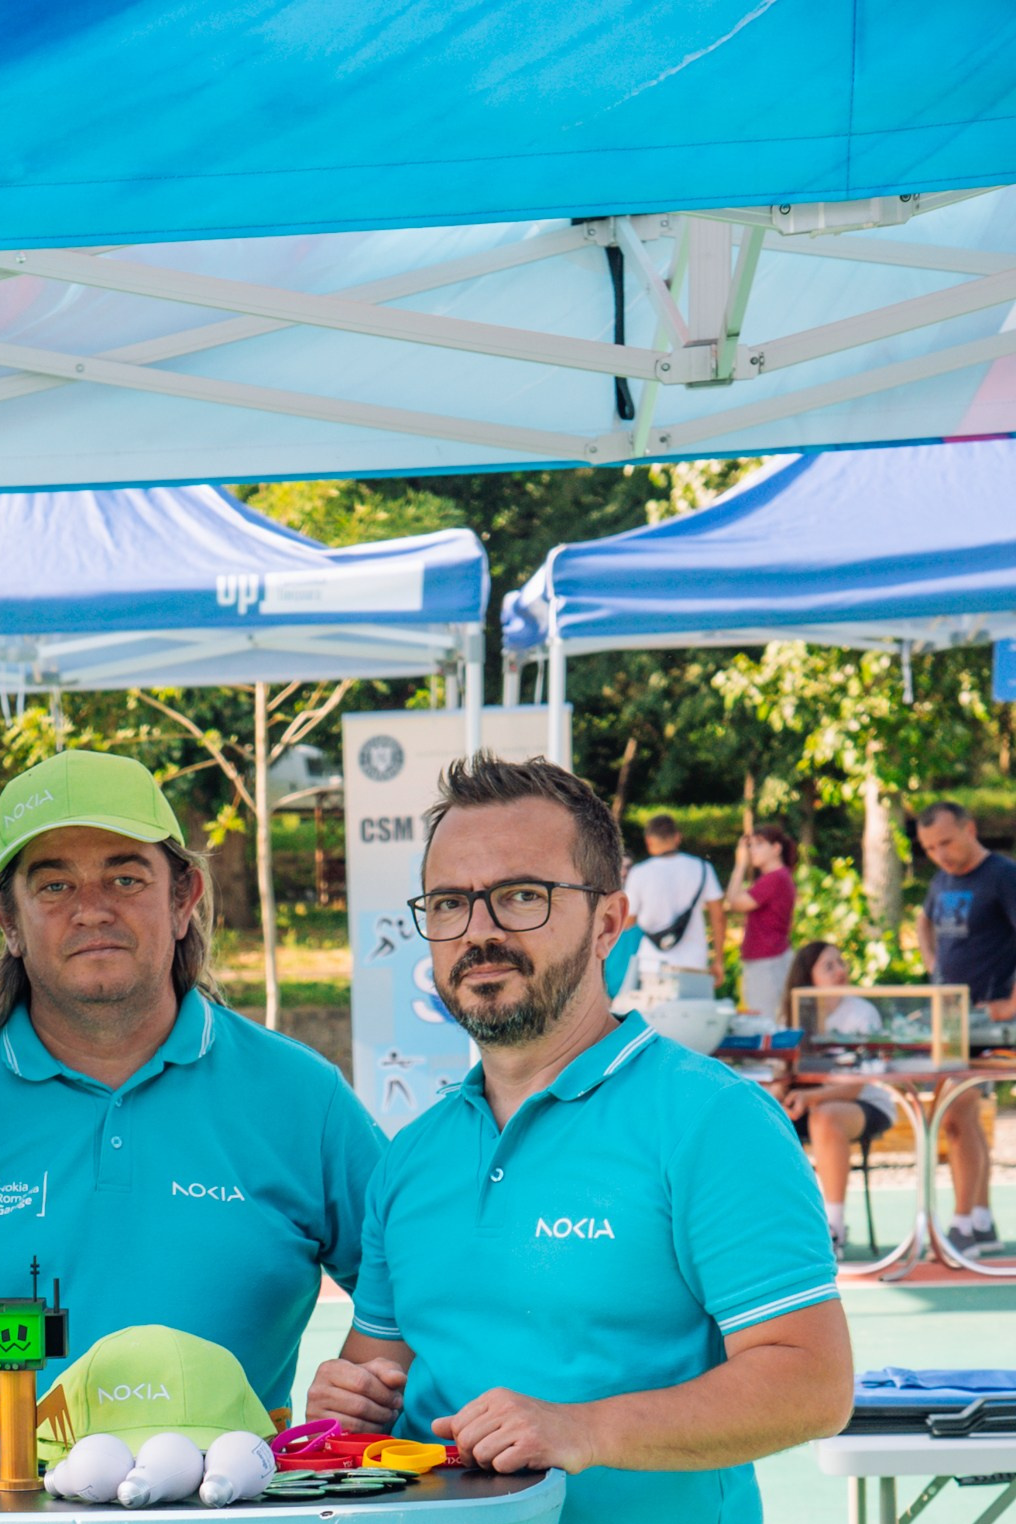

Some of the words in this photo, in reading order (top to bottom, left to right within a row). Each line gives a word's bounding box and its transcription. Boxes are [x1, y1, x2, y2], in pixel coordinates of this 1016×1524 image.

[4, 789, 54, 828] NOKIA
[360, 816, 413, 843] CSM
[172, 1181, 245, 1202] NOKIA
[535, 1217, 615, 1239] NOKIA
[97, 1383, 171, 1404] NOKIA
